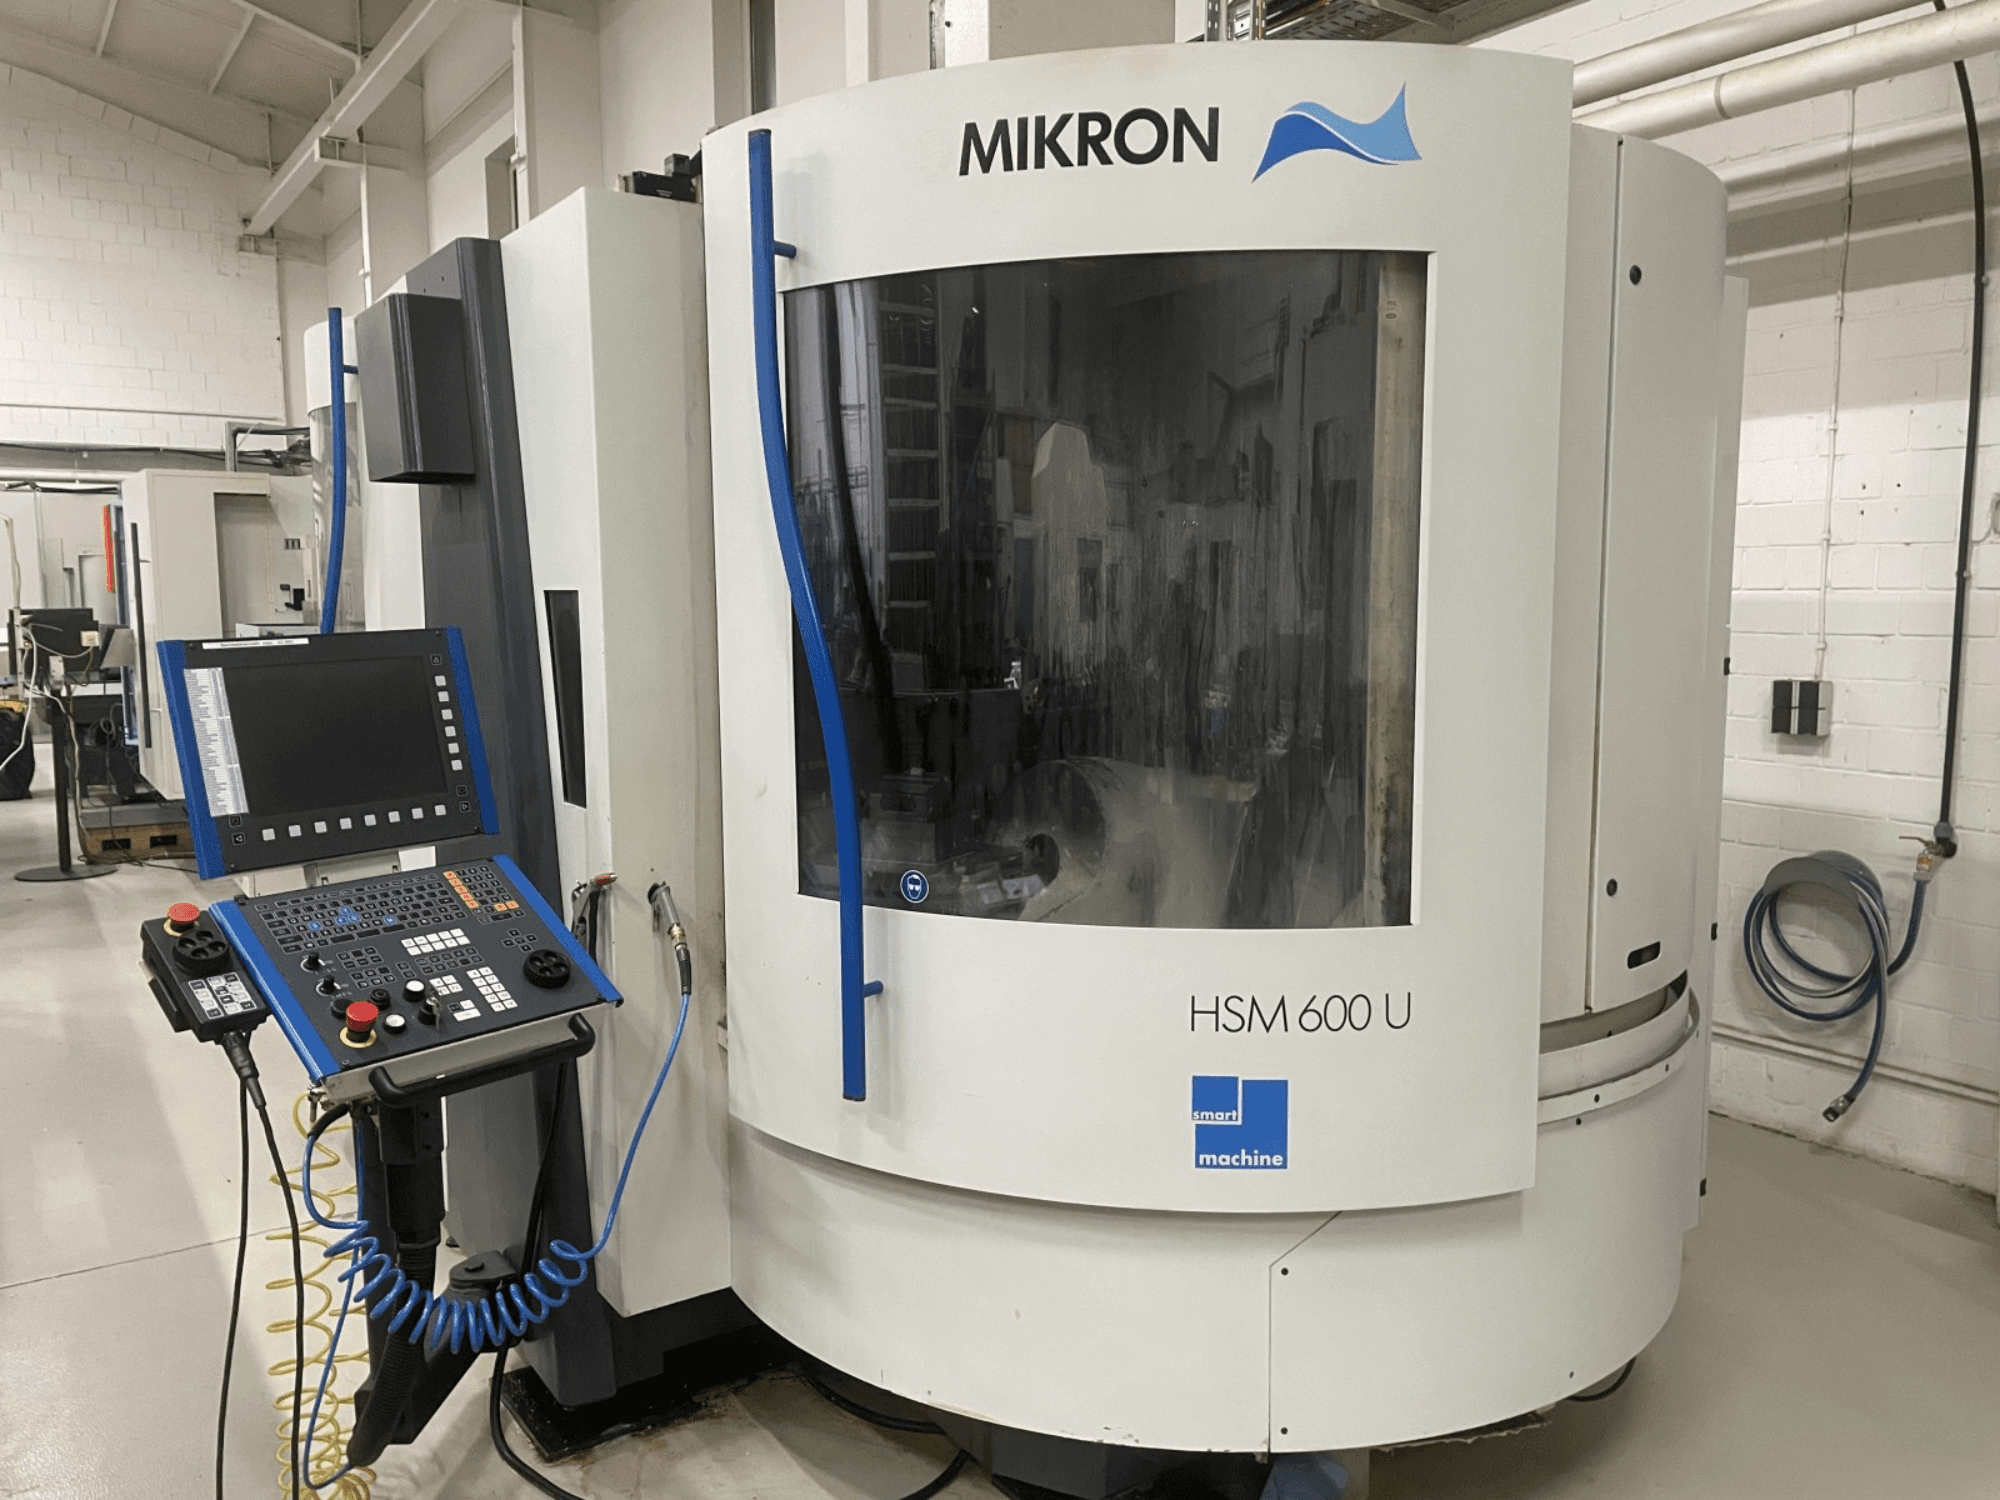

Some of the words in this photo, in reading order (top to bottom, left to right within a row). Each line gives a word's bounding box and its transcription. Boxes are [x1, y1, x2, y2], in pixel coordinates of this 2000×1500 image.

[959, 106, 1220, 176] MIKRON
[1190, 994, 1289, 1034] HSM
[1298, 994, 1372, 1032] 600
[1385, 991, 1411, 1030] U
[1193, 1110, 1237, 1120] smart
[1199, 1149, 1284, 1166] machine
